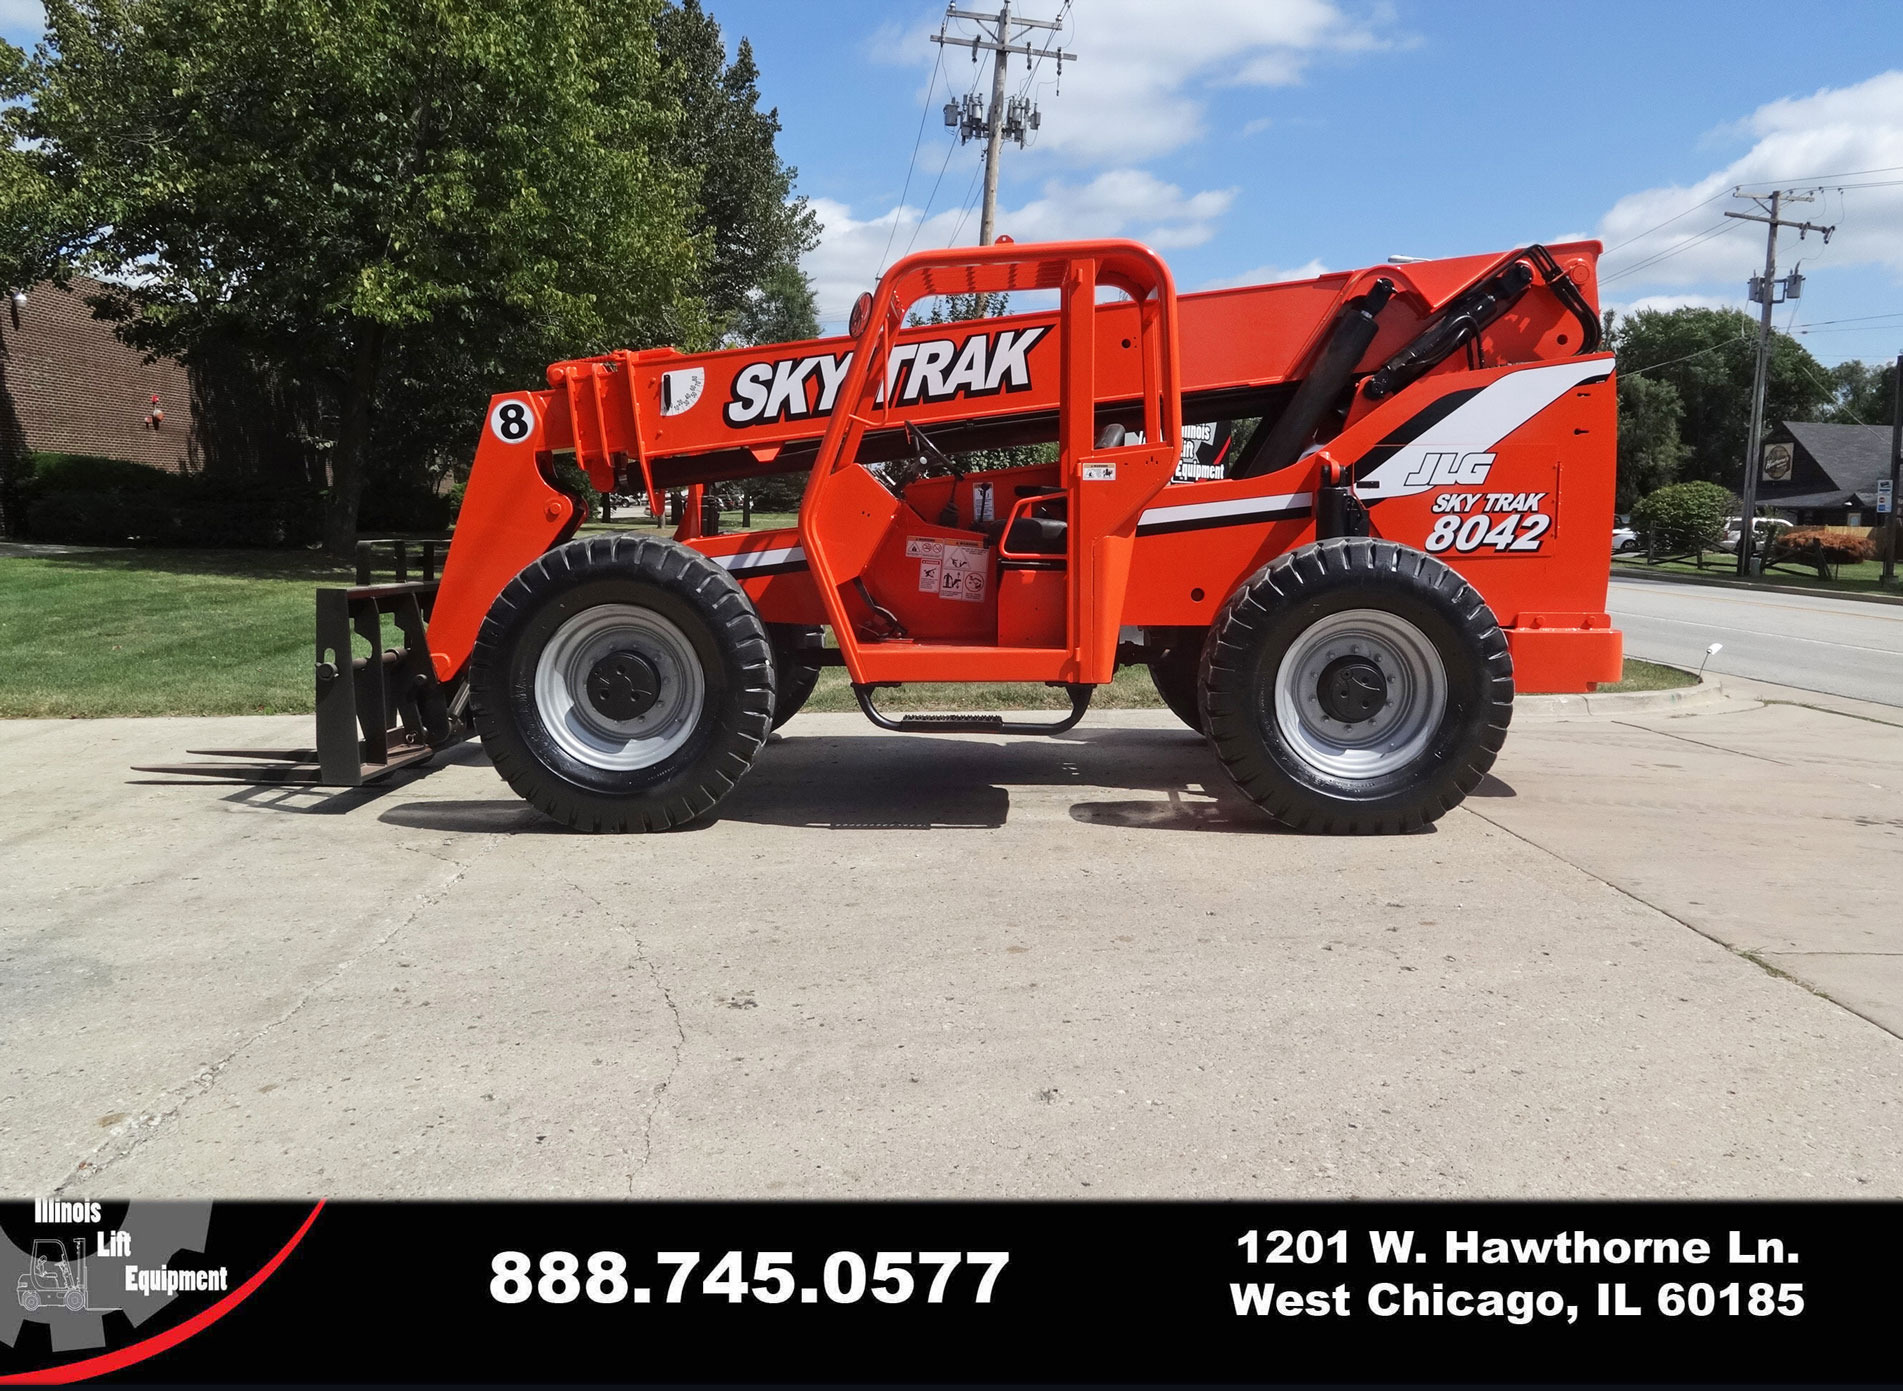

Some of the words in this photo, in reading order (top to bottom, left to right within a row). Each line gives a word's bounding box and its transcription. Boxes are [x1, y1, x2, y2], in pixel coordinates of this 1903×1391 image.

[723, 350, 856, 428] SKY
[873, 325, 1055, 409] TRAK
[500, 404, 528, 439] 8
[1181, 423, 1211, 440] llinois
[1180, 440, 1194, 458] ift
[1175, 459, 1225, 480] Equipment
[1403, 453, 1498, 486] JLG
[1432, 492, 1482, 514] SKY
[1483, 492, 1549, 514] TRAK
[1424, 513, 1552, 552] 8042
